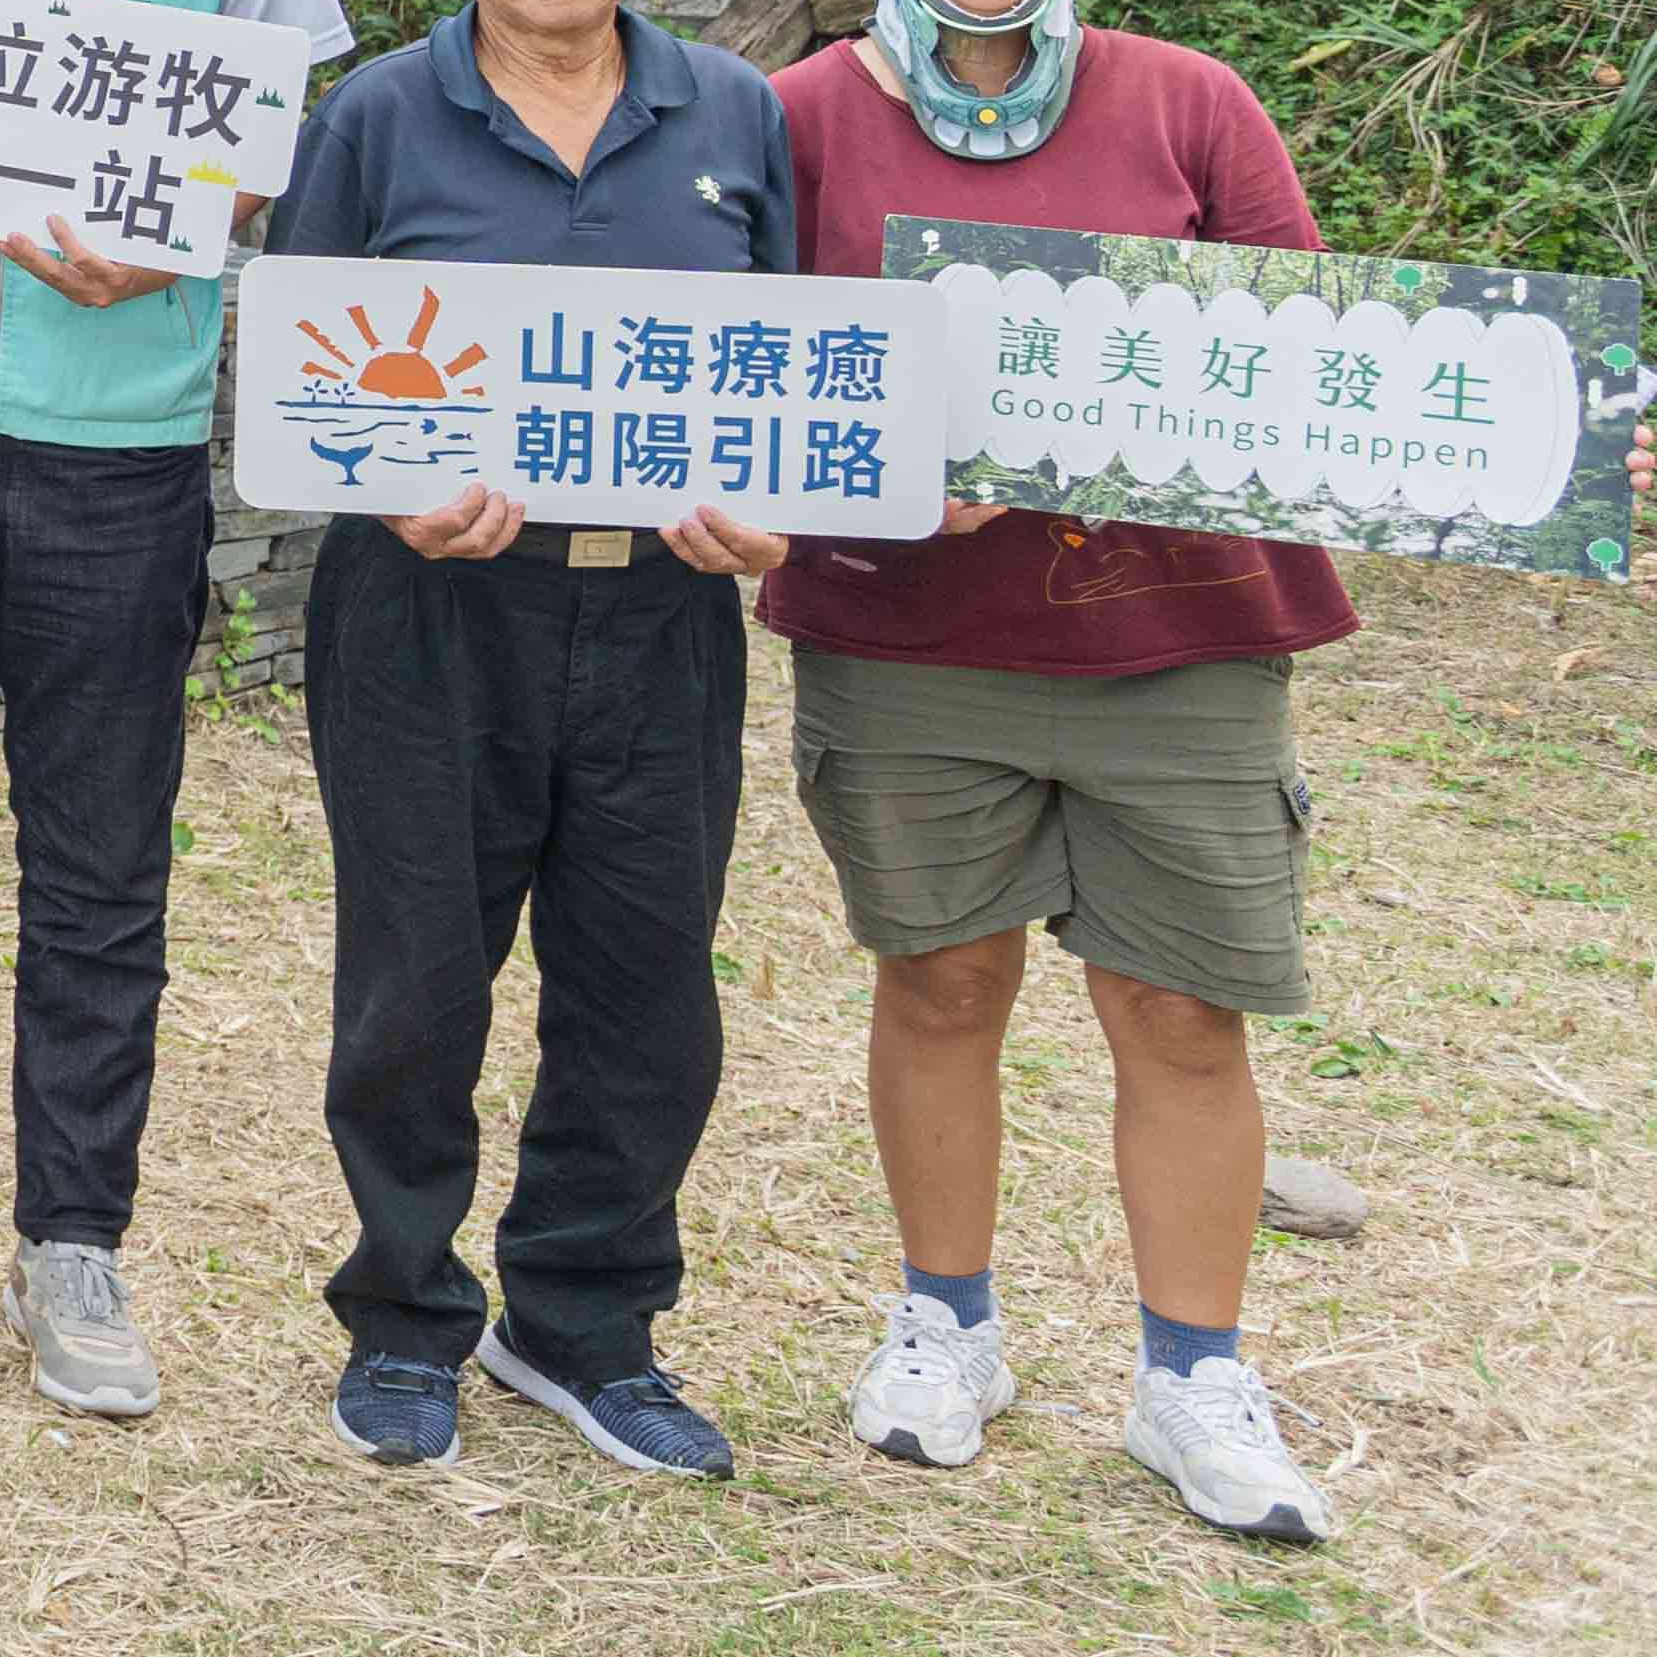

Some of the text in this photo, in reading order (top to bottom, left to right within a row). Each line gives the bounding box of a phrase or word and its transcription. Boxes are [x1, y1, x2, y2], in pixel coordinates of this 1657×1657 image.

[520, 311, 889, 402] 山海療癒
[998, 315, 1496, 425] 讓美好發生
[515, 405, 886, 499] 朝陽引路
[992, 389, 1488, 470] Good Things Happen
